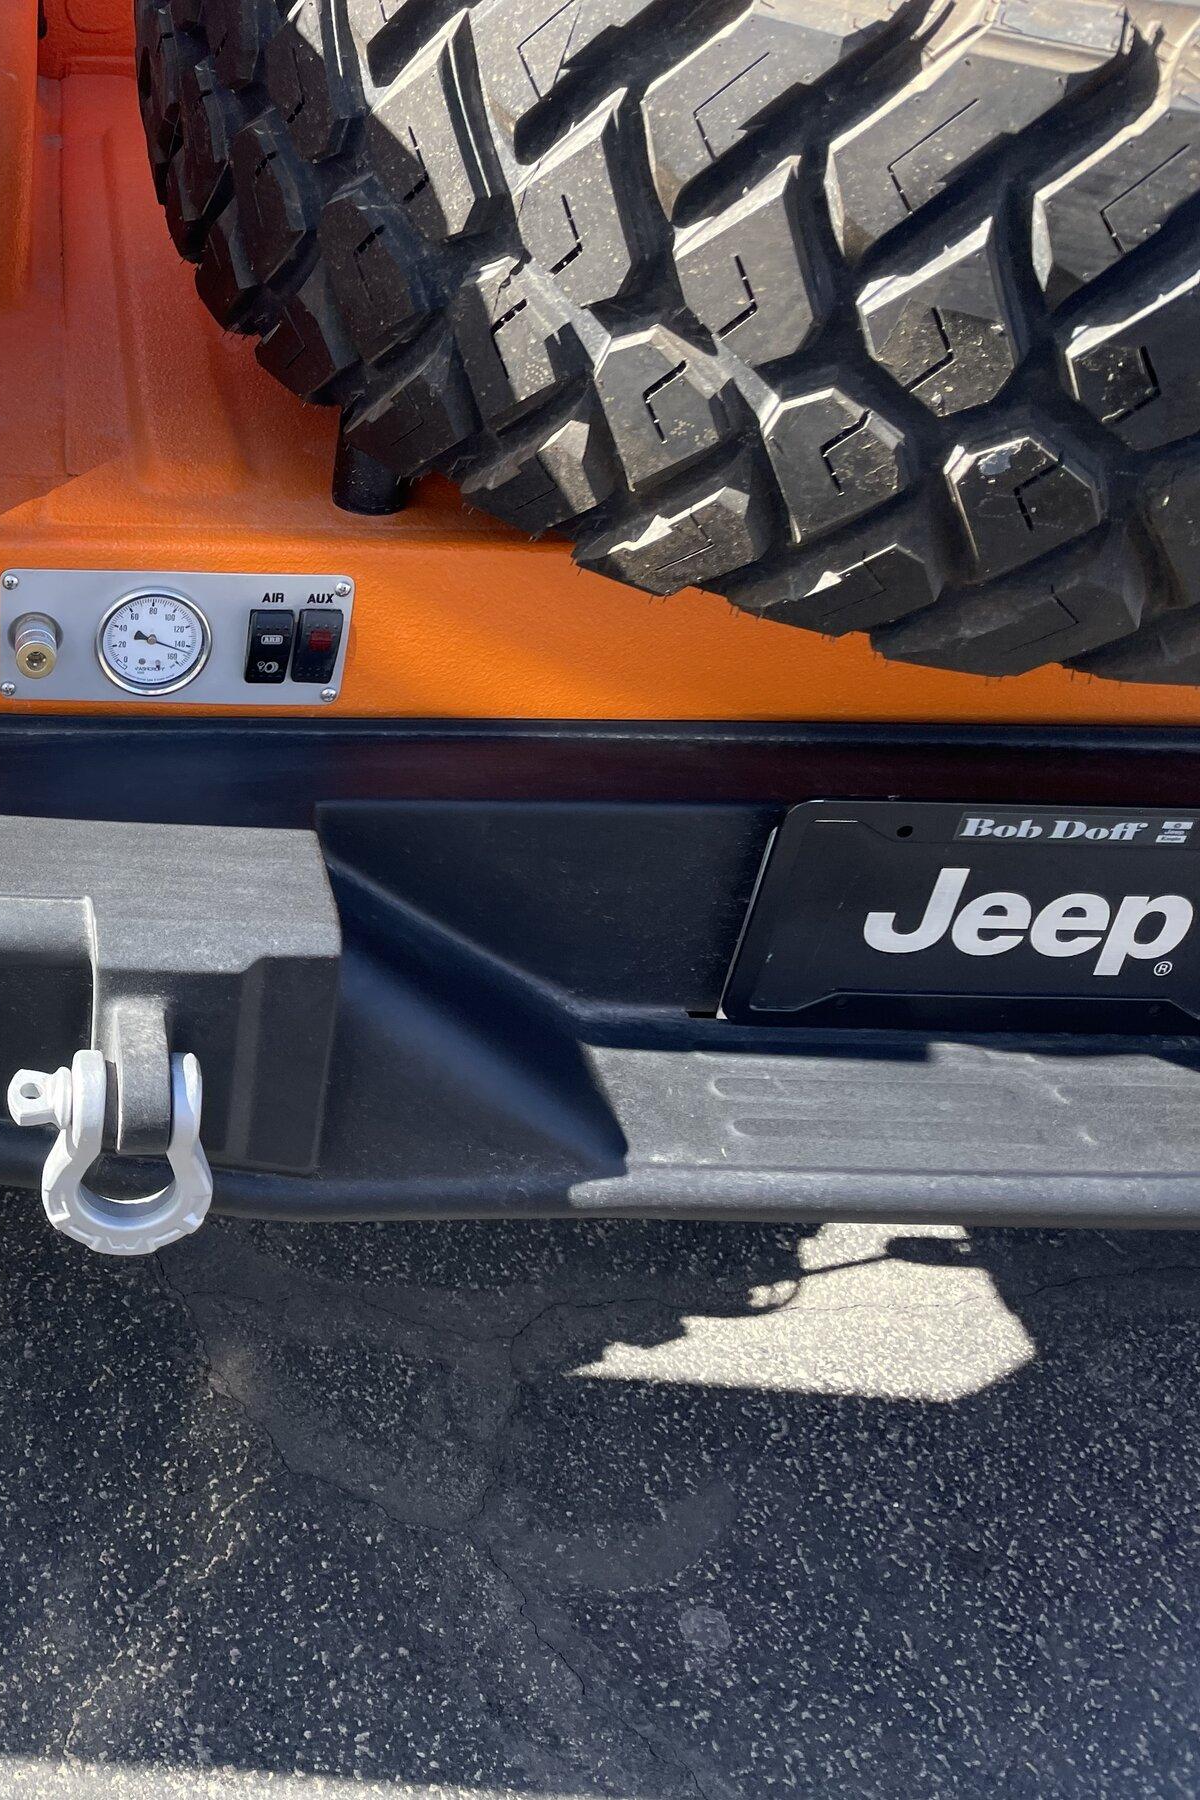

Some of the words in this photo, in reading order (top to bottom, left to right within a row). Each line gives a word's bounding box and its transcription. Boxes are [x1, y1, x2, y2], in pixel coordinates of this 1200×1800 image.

[262, 592, 285, 603] AIR
[307, 593, 335, 604] AUX
[149, 607, 158, 615] 80
[130, 613, 139, 621] 60
[164, 613, 176, 621] 100
[118, 624, 128, 632] 40
[173, 625, 185, 633] 120
[174, 640, 186, 648] 140
[167, 652, 178, 660] 160
[959, 817, 1043, 838] Bob
[1047, 820, 1149, 841] Doff
[863, 867, 1194, 976] Jeep
